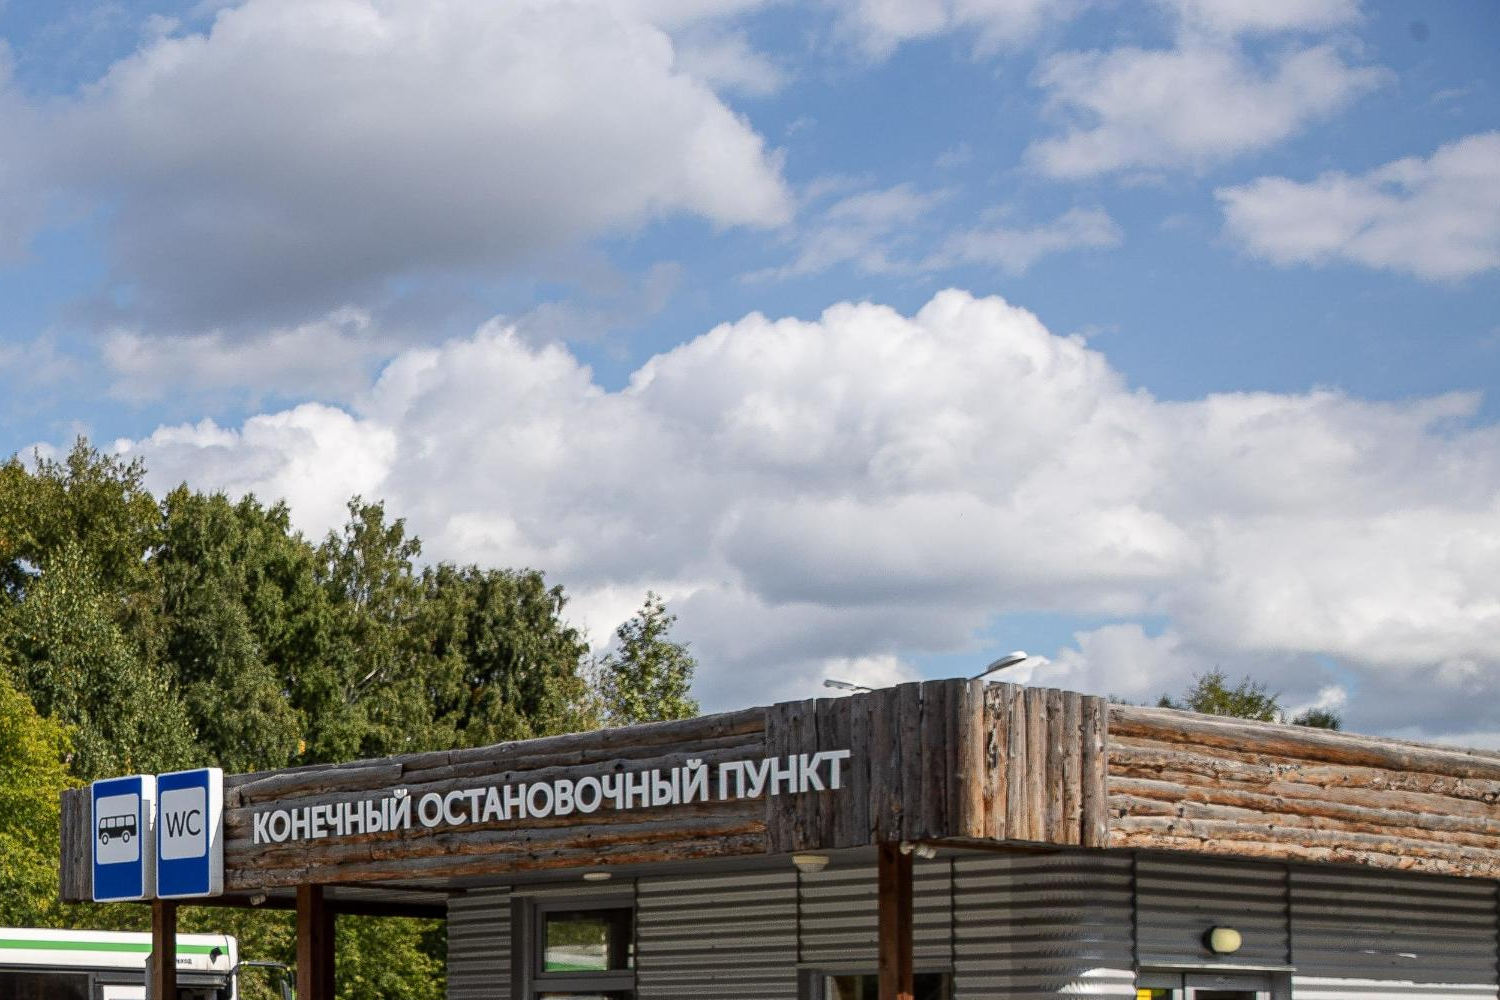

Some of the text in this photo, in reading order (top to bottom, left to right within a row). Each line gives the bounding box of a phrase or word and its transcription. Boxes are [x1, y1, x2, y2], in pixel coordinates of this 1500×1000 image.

[165, 809, 202, 838] WC
[253, 749, 851, 844] КОНЕЧНЫЙ ОСТАНОВОЧНЫЙ ПУНКТ
